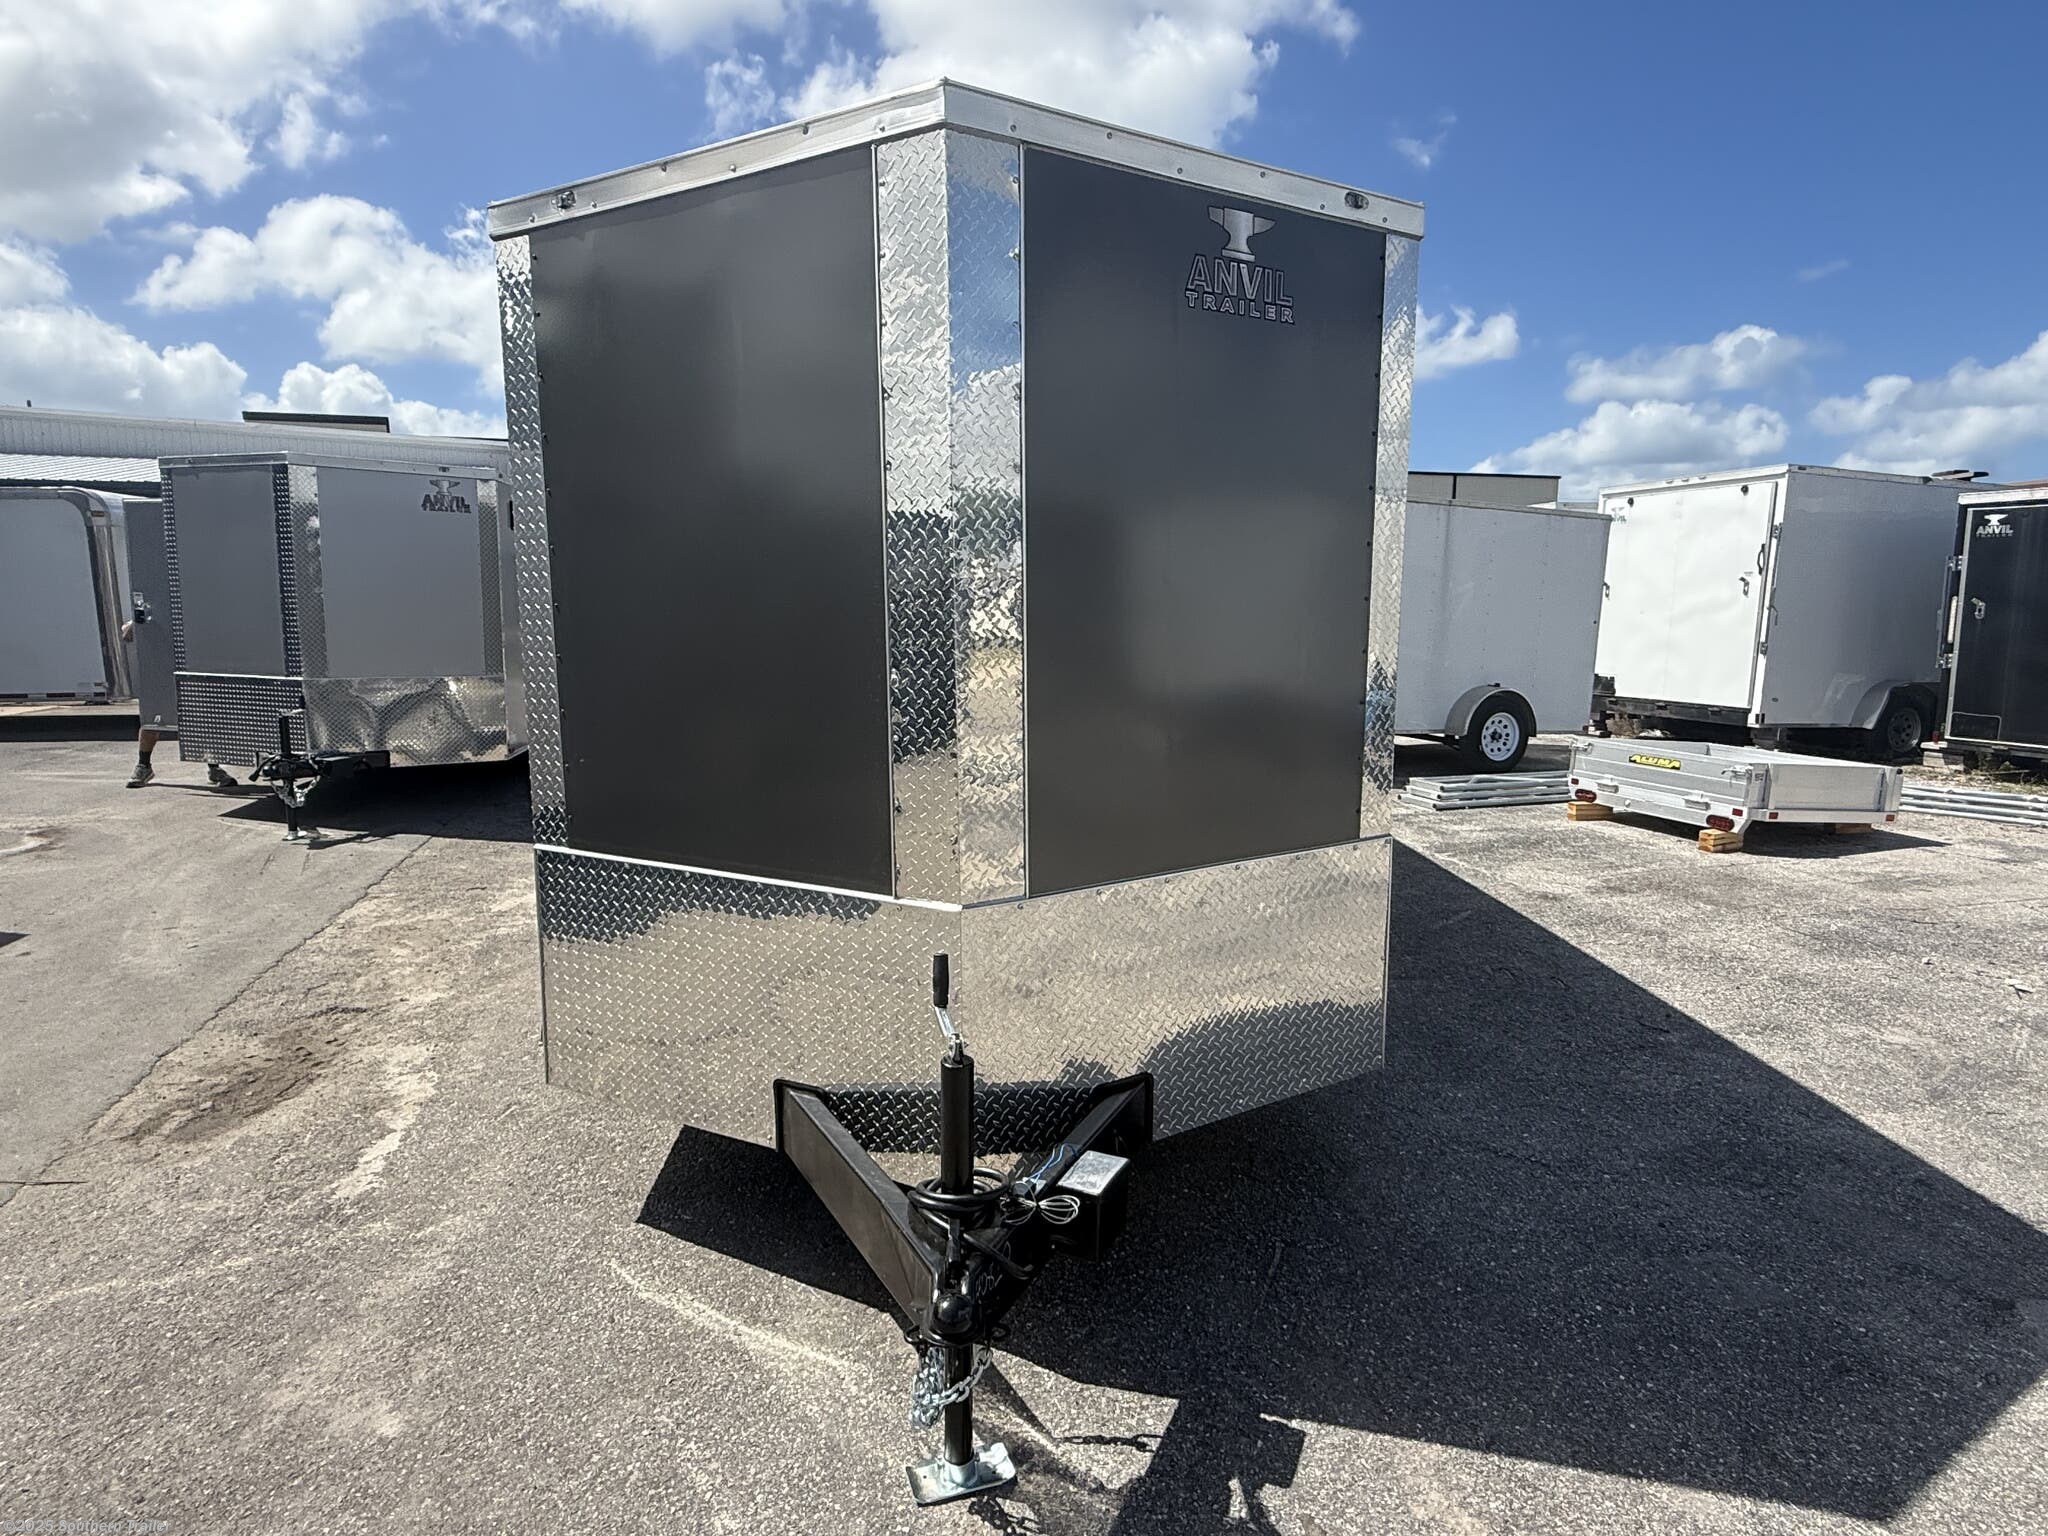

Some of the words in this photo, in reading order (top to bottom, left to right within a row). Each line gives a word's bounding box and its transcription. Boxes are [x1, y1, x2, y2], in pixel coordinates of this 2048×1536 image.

[1186, 254, 1293, 306] ANVIL
[1185, 291, 1295, 324] TRAILER
[422, 493, 470, 510] ANVIL
[1976, 524, 2014, 535] ANVIL
[1630, 754, 1681, 769] ALUMA
